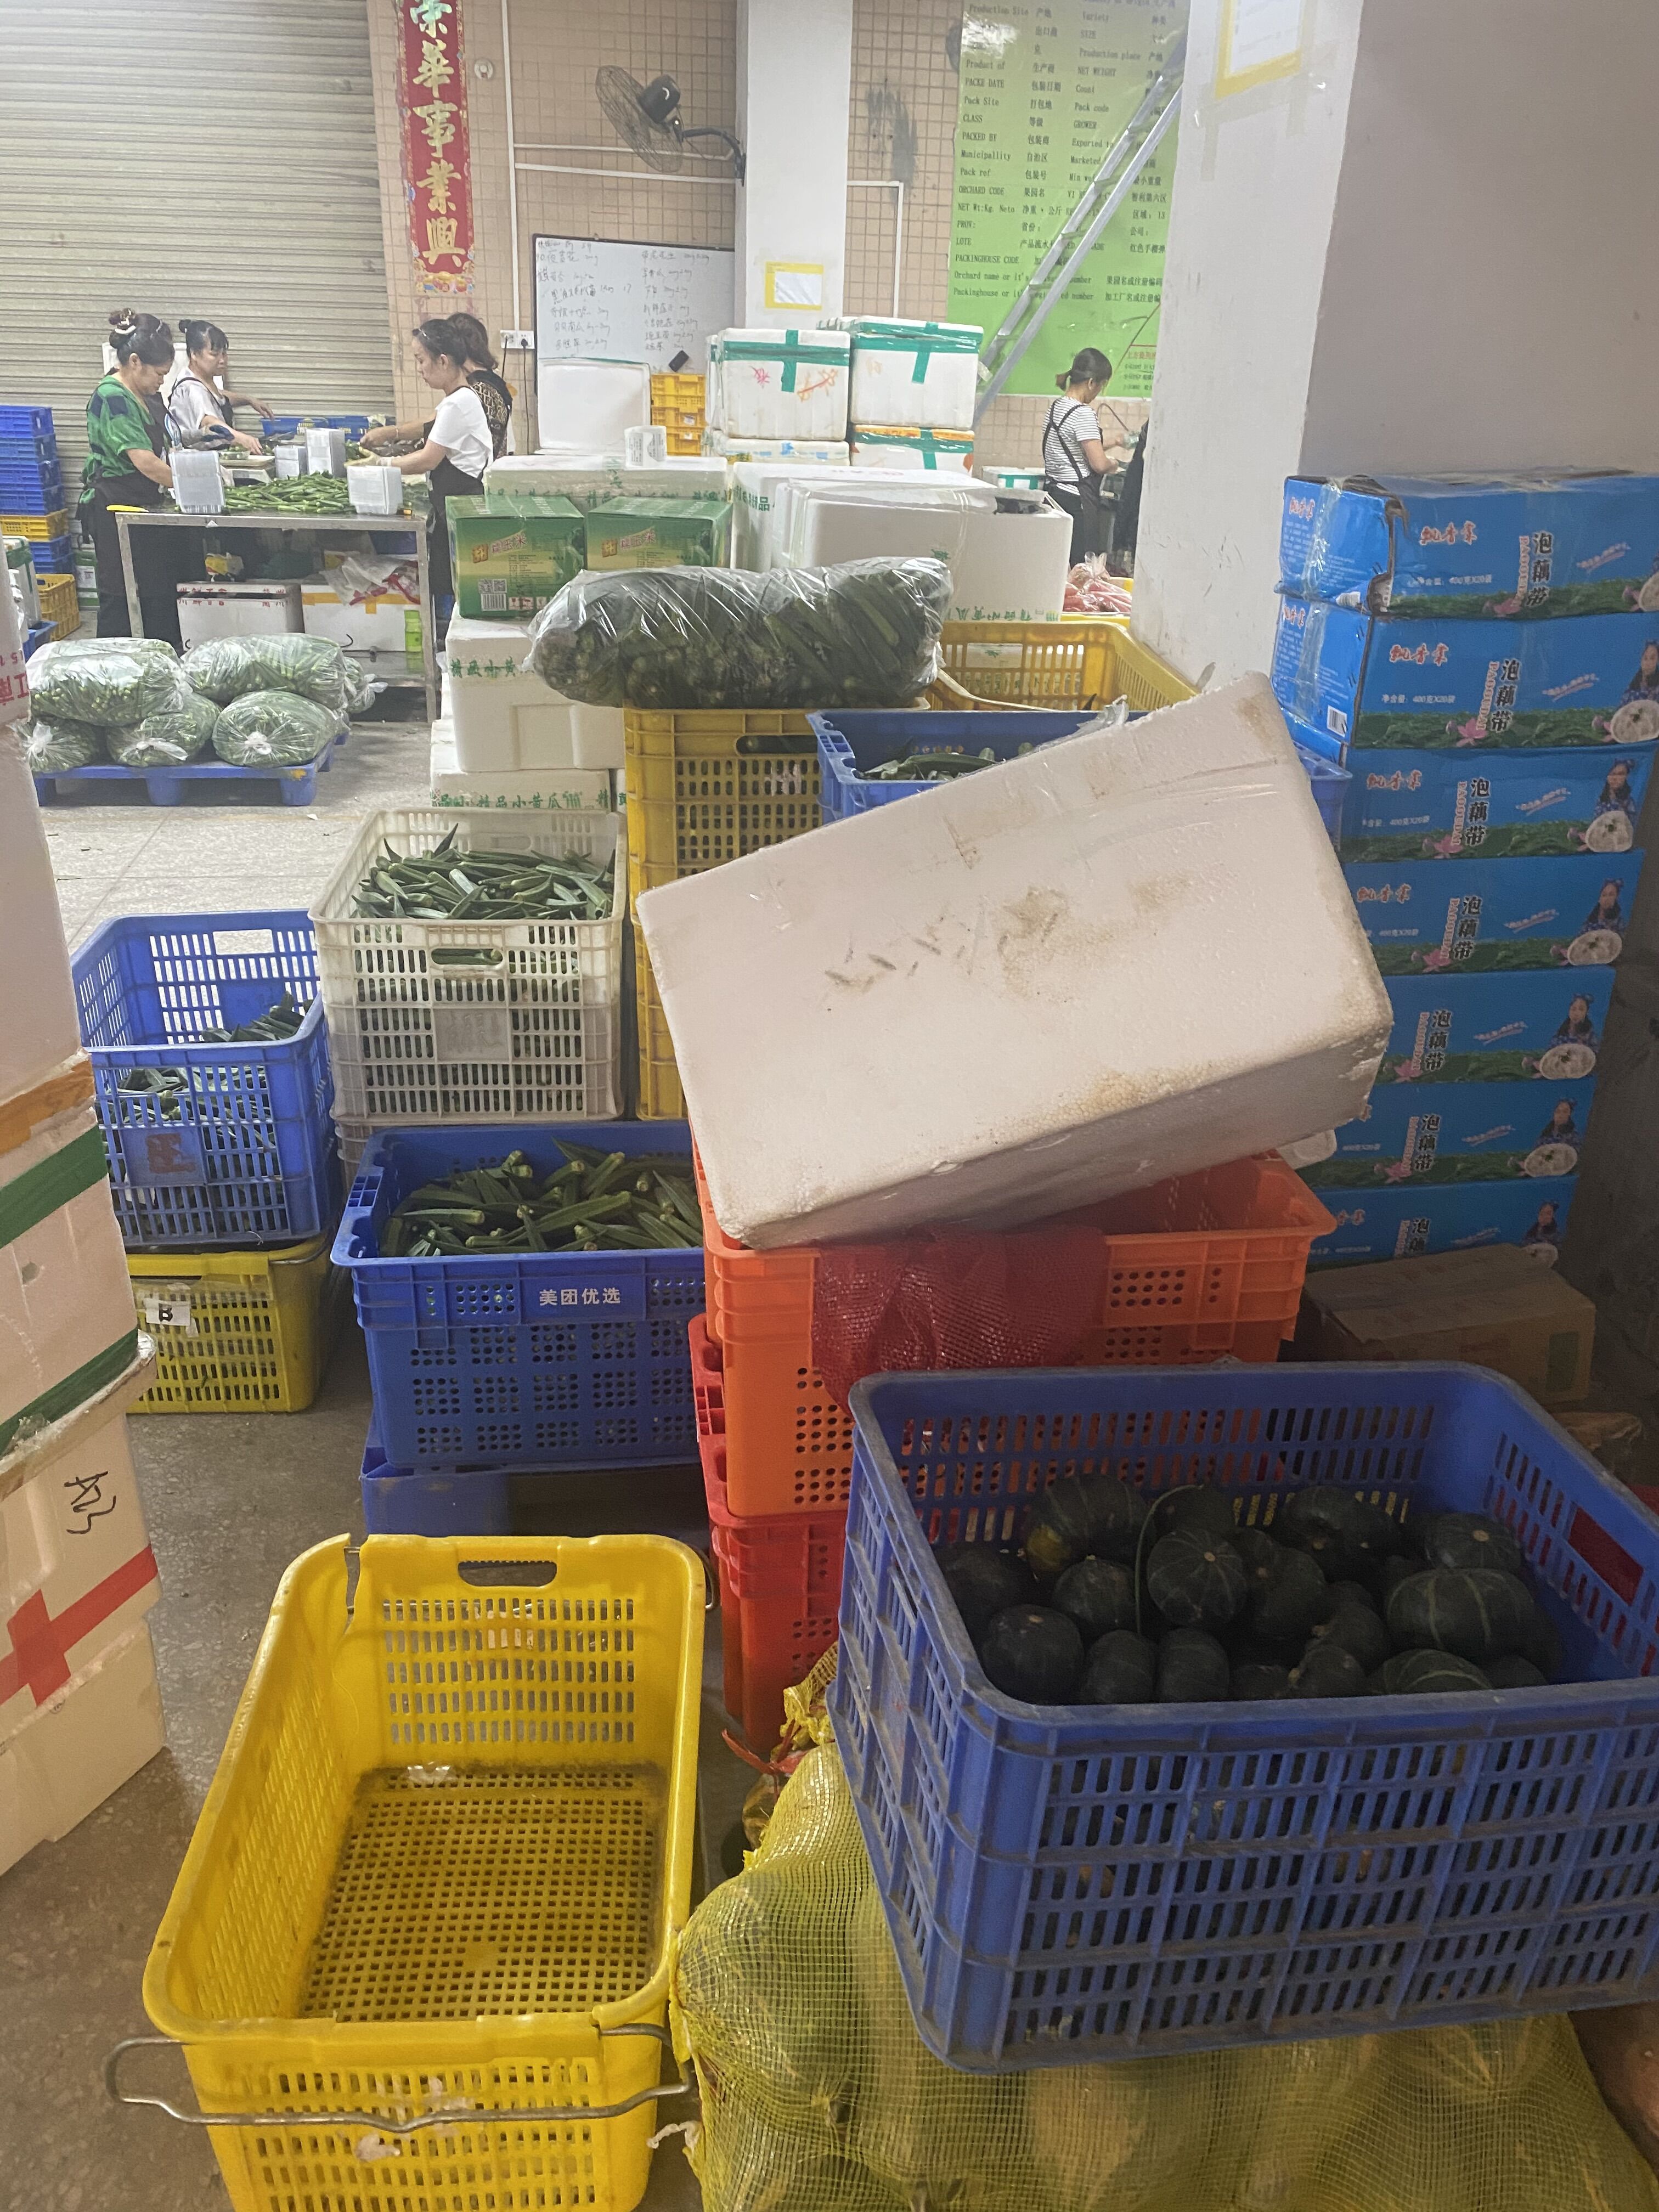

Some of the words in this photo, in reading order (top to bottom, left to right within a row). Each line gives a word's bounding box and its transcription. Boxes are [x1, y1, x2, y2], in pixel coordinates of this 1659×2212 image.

[966, 59, 993, 69] Product
[997, 61, 1005, 70] of
[1078, 66, 1089, 75] NET
[988, 79, 1005, 88] DATE
[983, 97, 1000, 106] Site
[1075, 102, 1090, 111] Pack
[963, 114, 983, 123] CLASS
[962, 131, 986, 141] PACKED
[989, 133, 997, 142] BY
[1071, 138, 1103, 148] Exported
[960, 167, 976, 176] Pack
[979, 168, 991, 177] ref
[1069, 173, 1081, 182] Min
[958, 185, 986, 195] ORCHARD
[989, 187, 1005, 196] CODE
[957, 202, 970, 211] NET
[999, 205, 1015, 213] Neto
[956, 237, 972, 246] LOTE
[955, 254, 1001, 264] PACKINGHOUSE
[1003, 256, 1019, 264] CODE
[953, 272, 981, 280] Orchard
[953, 287, 998, 297] Packinghouse
[539, 1286, 621, 1306] 美团优选
[158, 1302, 173, 1322] B
